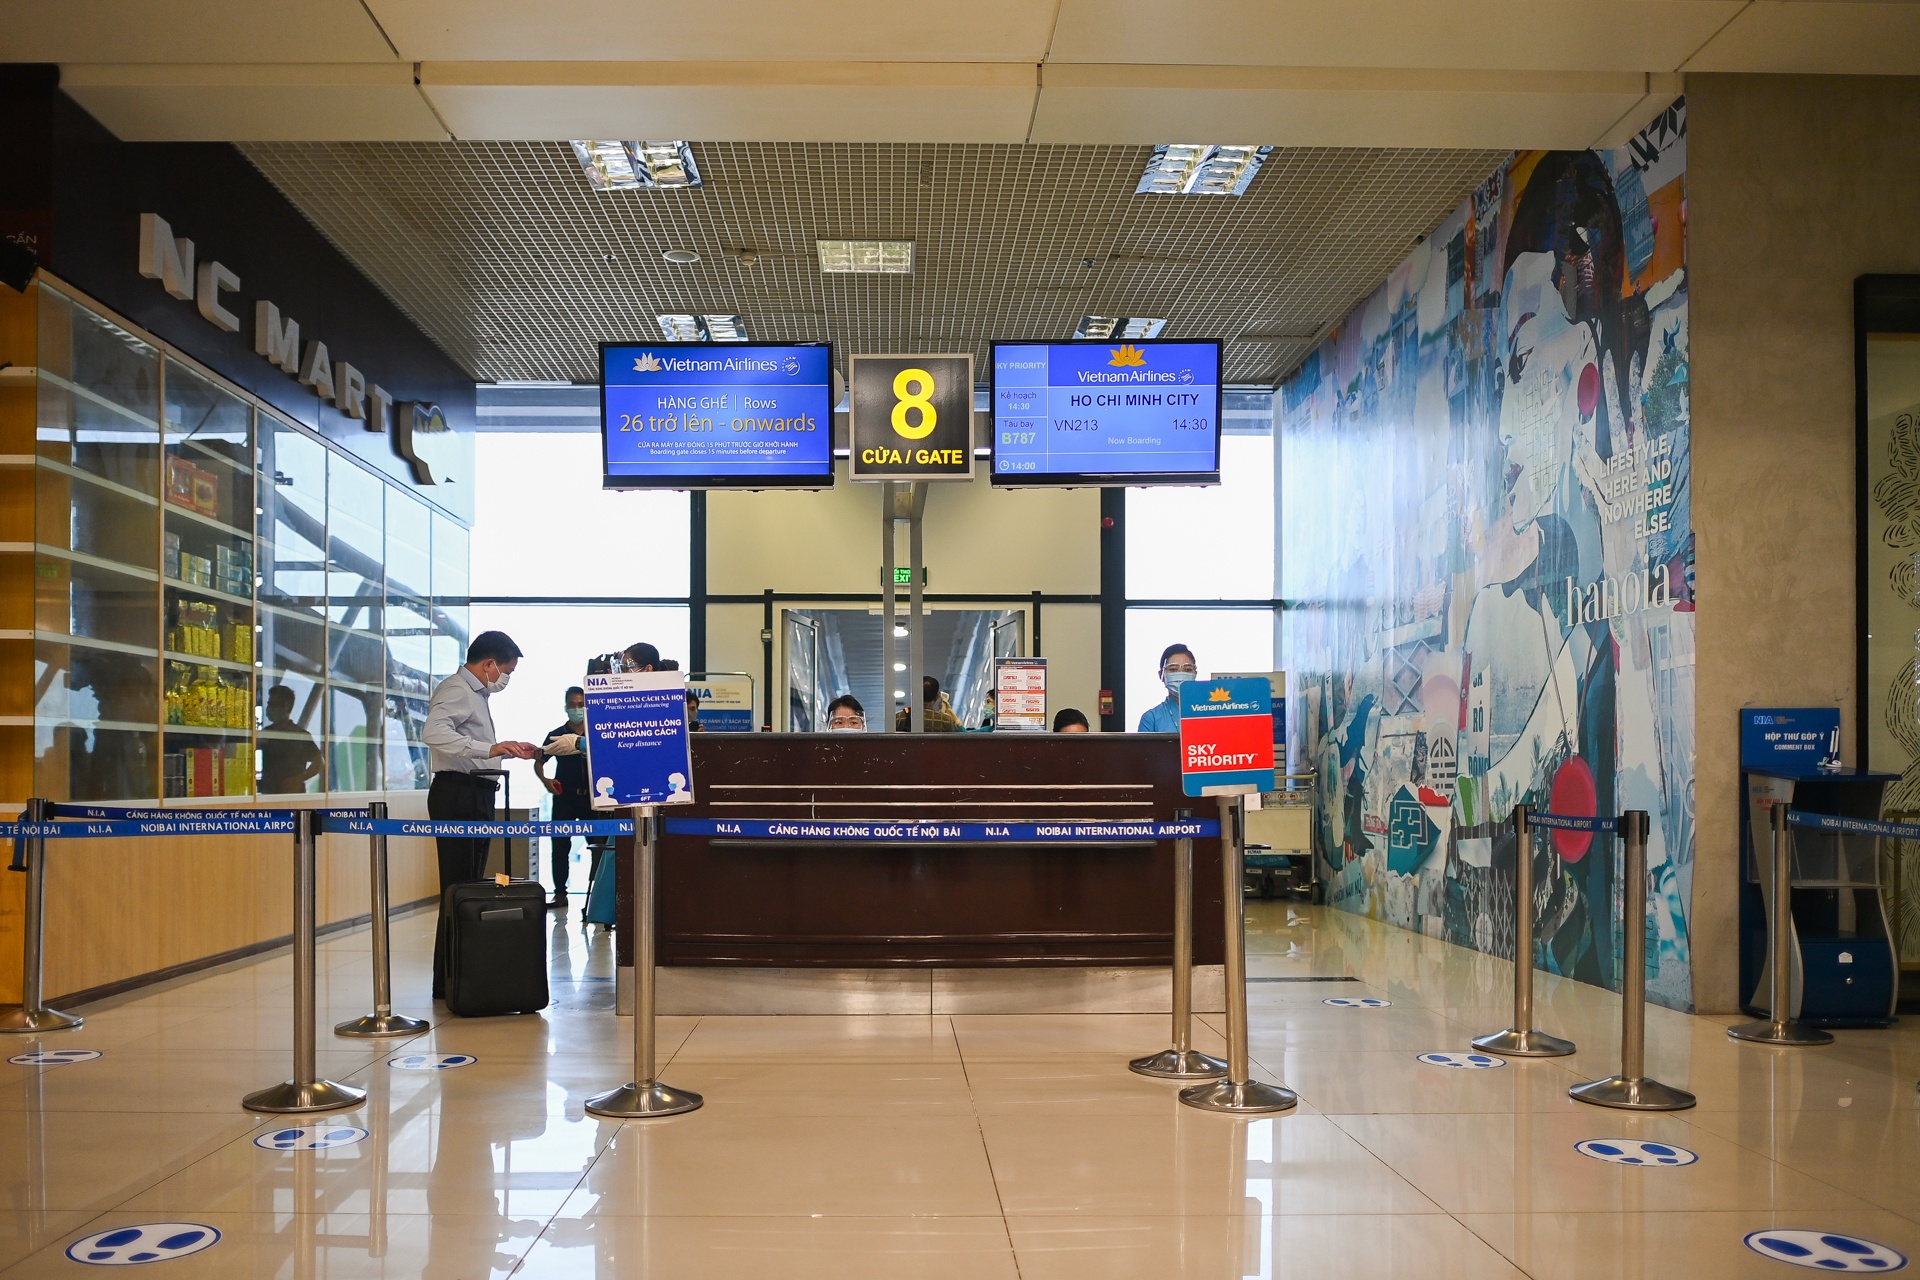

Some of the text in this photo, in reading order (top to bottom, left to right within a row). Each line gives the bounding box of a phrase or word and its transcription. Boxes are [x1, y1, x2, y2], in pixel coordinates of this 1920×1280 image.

[139, 213, 392, 433] NC MART
[658, 393, 777, 409] HÀNG GHẾ Rows
[891, 368, 937, 440] 8
[1071, 394, 1200, 406] HO CHI MINH CITY
[620, 412, 816, 432] 26 trở lên onwards
[1020, 420, 1034, 429] bay
[1054, 418, 1208, 431] VN213 14:30
[660, 440, 674, 448] MÁY
[687, 440, 706, 448] ĐÓNG
[732, 440, 752, 448] TRƯỚC
[1002, 432, 1036, 444] B787
[1108, 436, 1162, 446] Now Boarding
[862, 446, 902, 464] CỬA
[916, 450, 963, 464] GATE
[1600, 433, 1672, 478] LIFESTYLE,
[1011, 462, 1036, 470] 14:00
[1604, 459, 1671, 500] HERE AND
[1604, 484, 1672, 525] NOWHERE
[1634, 510, 1672, 540] ELSE.
[1565, 553, 1678, 628] hanoia
[587, 678, 608, 686] NIA
[587, 698, 606, 706] THỰC
[594, 722, 612, 730] QUÝ
[614, 721, 642, 730] KHÁCH
[659, 718, 682, 726] LÒNG
[1754, 716, 1774, 724] NIA
[601, 728, 677, 739] GIỮ KHOẢNG CÁCH
[1764, 732, 1782, 742] HỘP
[1784, 732, 1800, 740] THƯ
[1801, 732, 1817, 740] GÓP
[618, 741, 634, 749] Keep
[1188, 744, 1216, 756] SKY
[1188, 754, 1255, 768] PRIORITY
[126, 810, 149, 819] CẢNG
[1528, 815, 1540, 824] NOIBAI
[1541, 817, 1572, 828] INTERNATIONAL
[1574, 820, 1592, 828] AIRPORT
[1822, 818, 1841, 828] NOIBAI
[1842, 820, 1890, 834] INTERNATIONAL
[1891, 826, 1919, 836] AIRPORT
[7, 824, 19, 834] TẾ
[22, 824, 40, 836] NỘI
[88, 825, 112, 834] N.I.A
[140, 823, 176, 832] NOIBAI
[180, 822, 260, 832] INTERNATIONAL
[264, 821, 294, 830] AIRPO
[350, 822, 374, 831] N.I.A
[402, 822, 432, 834] CẢNG
[468, 824, 504, 834] KHÔNG
[507, 822, 536, 834] QUỐC
[540, 822, 552, 834] TẾ
[554, 824, 572, 836] NỘI
[717, 824, 741, 833] N.I.A
[768, 823, 798, 835] CẢNG
[834, 826, 870, 836] KHÔNG
[874, 824, 903, 836] QUỐC
[906, 824, 919, 836] TẾ
[921, 826, 939, 838] NỘI
[986, 827, 1010, 836] N.I.A
[1036, 827, 1072, 836] NOIBAI
[1076, 826, 1154, 836] INTERNATIONAL
[1158, 825, 1202, 834] AIRPORT
